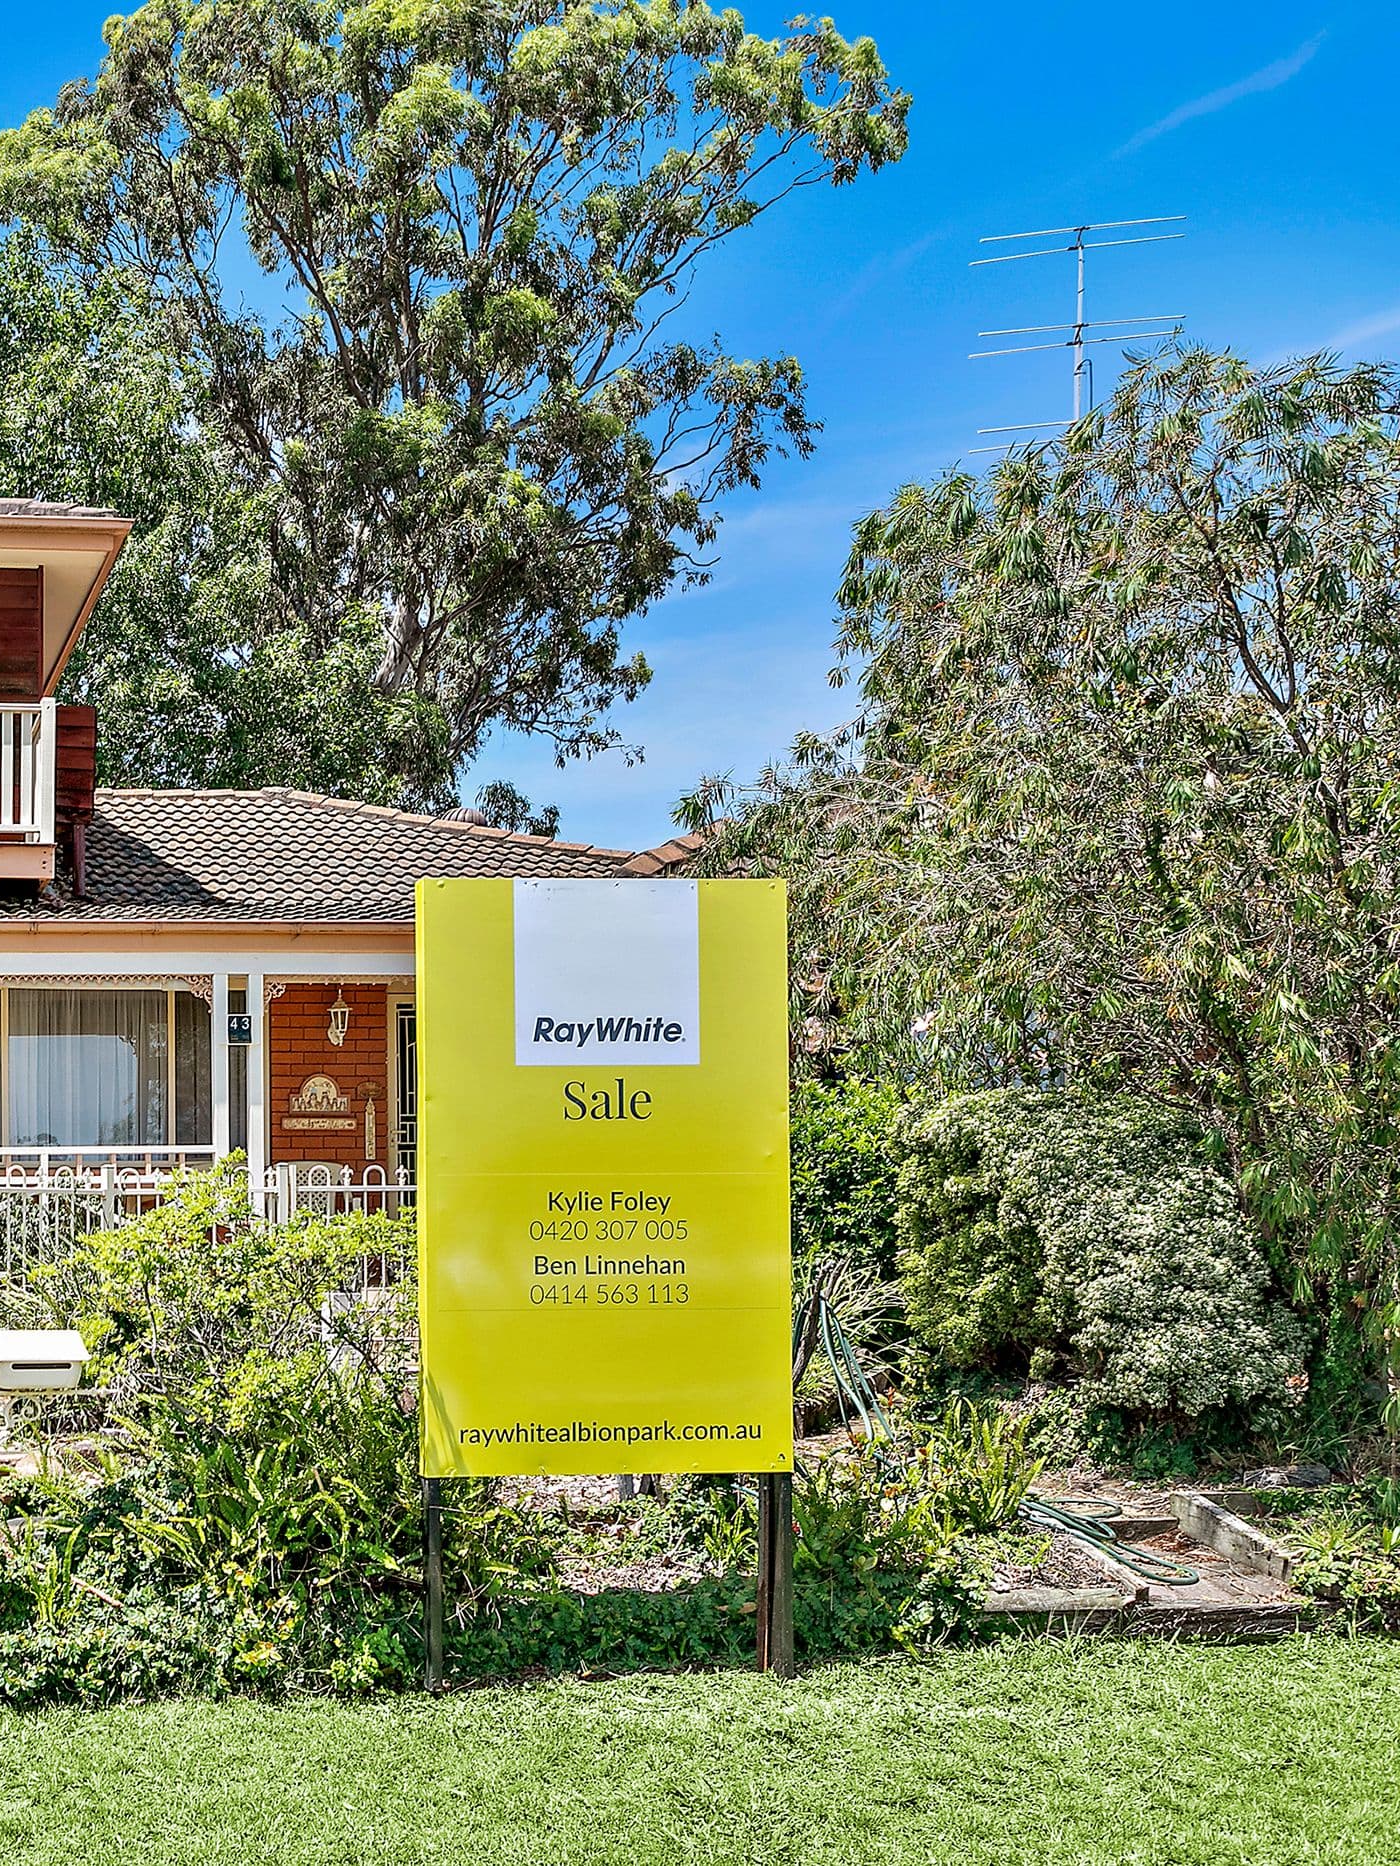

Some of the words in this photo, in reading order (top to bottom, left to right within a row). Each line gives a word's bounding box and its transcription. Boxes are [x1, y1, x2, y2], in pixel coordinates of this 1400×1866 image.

[230, 1017, 250, 1030] 43
[563, 1078, 652, 1121] Sale
[548, 1191, 603, 1216] Kylie
[611, 1191, 671, 1215] Foley
[529, 1220, 589, 1241] 0420
[595, 1220, 638, 1241] 307
[645, 1220, 688, 1240] 005
[534, 1255, 576, 1275] Ben
[585, 1255, 685, 1275] Linnehan
[530, 1284, 588, 1305] 0414
[597, 1284, 639, 1304] 563
[647, 1283, 689, 1304] 113
[459, 1420, 762, 1448] raywhitealbionpark.com.au
